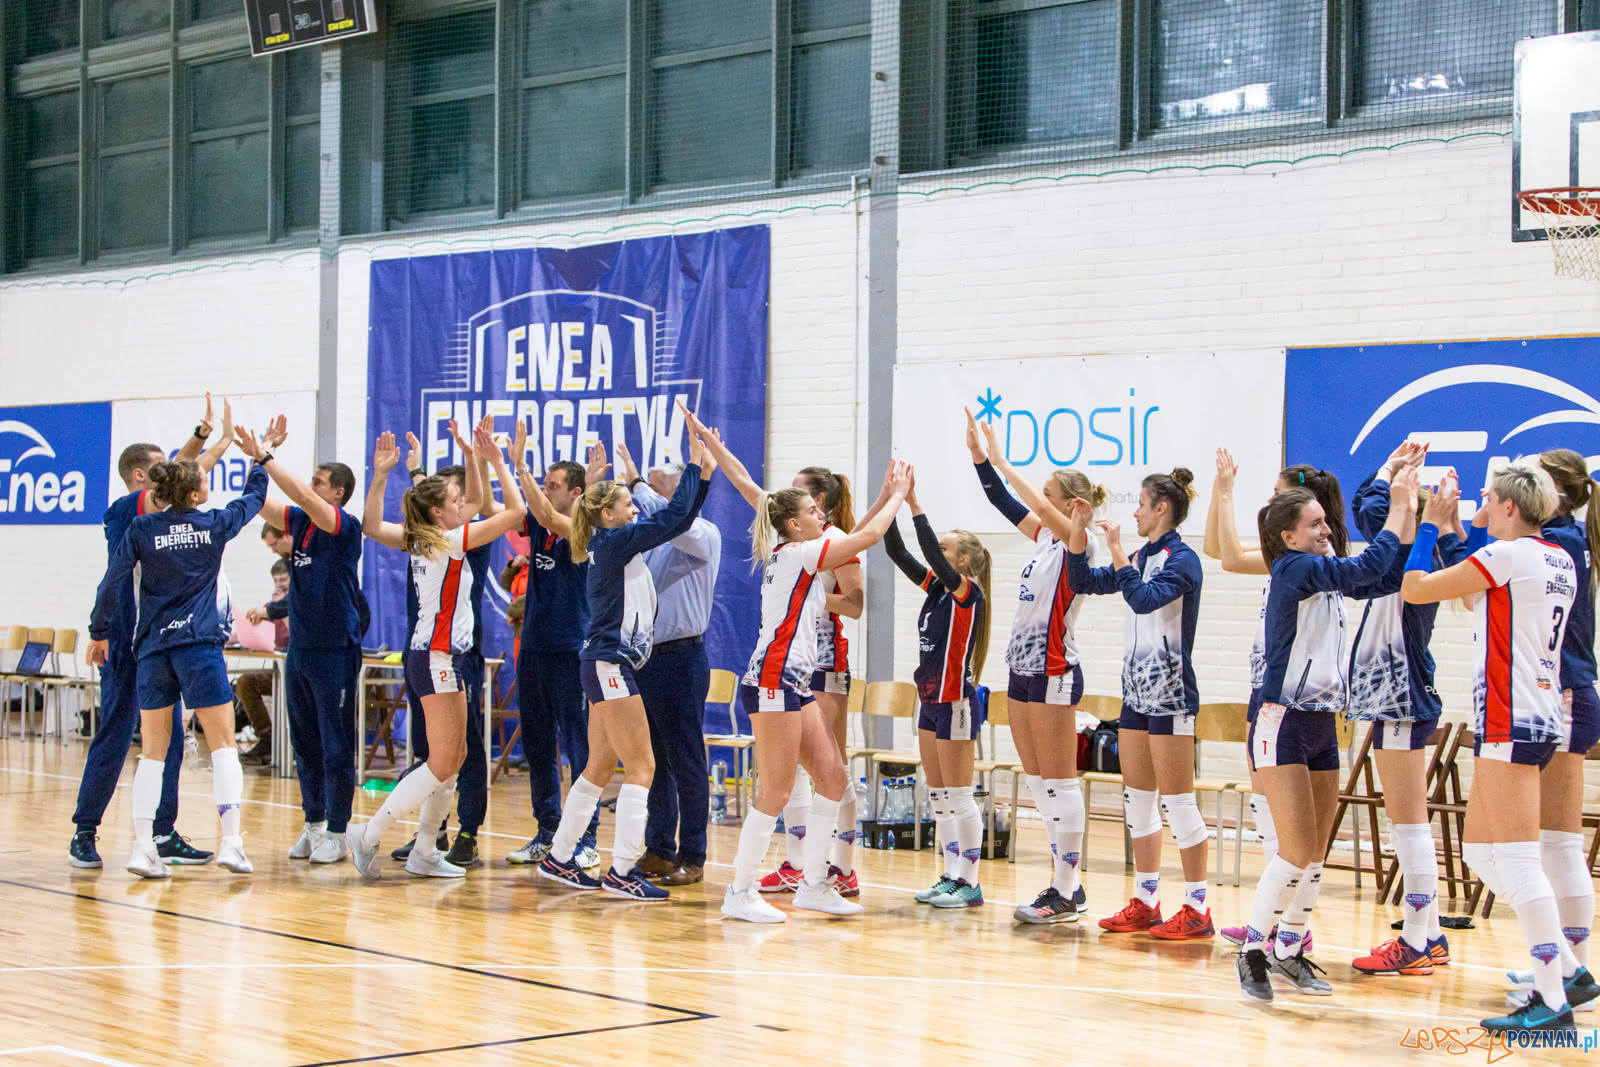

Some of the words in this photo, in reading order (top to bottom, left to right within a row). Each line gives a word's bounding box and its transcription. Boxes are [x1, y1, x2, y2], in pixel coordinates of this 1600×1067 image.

[505, 321, 613, 392] ENEA
[1005, 387, 1160, 485] posir
[0, 458, 86, 513] nea
[169, 523, 194, 534] ENEA
[154, 530, 212, 551] ENERGETYK
[1549, 605, 1564, 652] 3
[439, 671, 449, 682] 2
[608, 677, 619, 689] 4
[767, 688, 776, 700] 9
